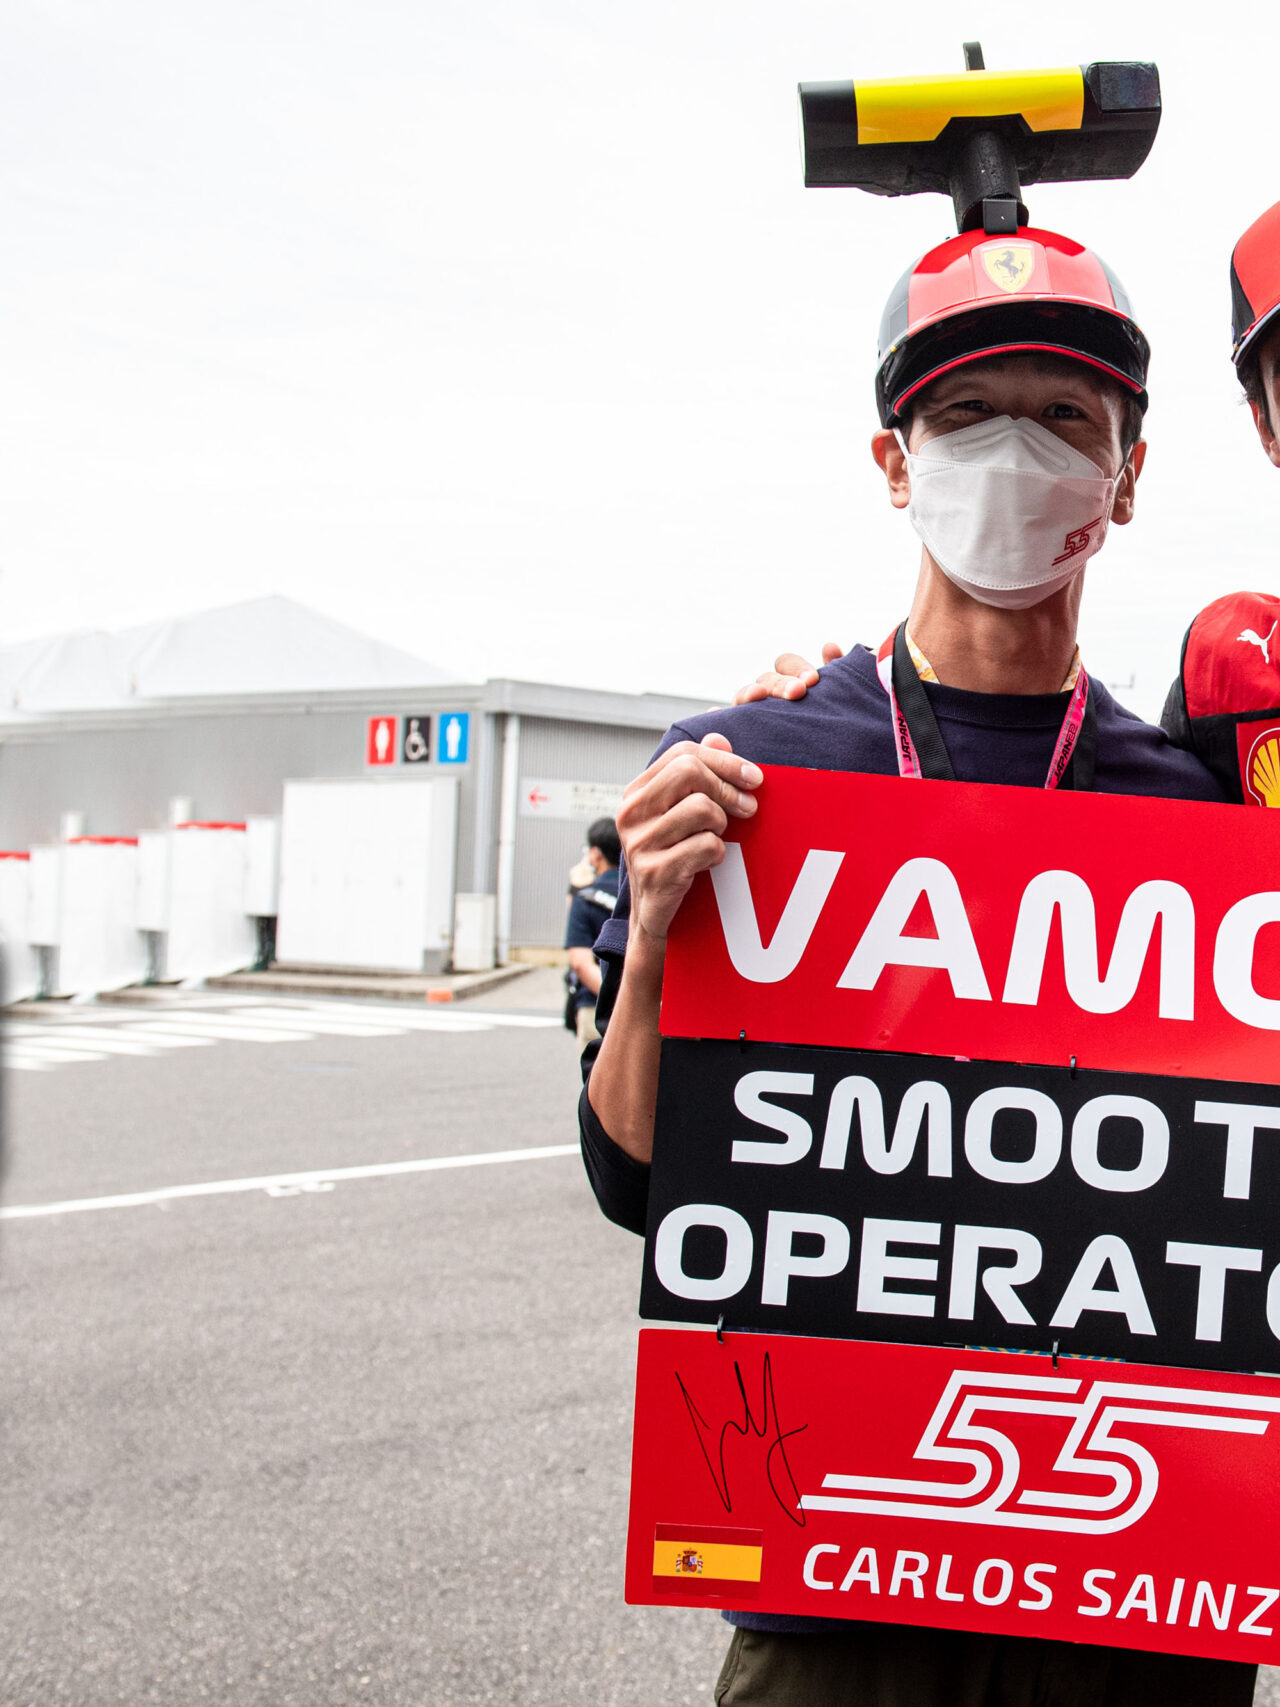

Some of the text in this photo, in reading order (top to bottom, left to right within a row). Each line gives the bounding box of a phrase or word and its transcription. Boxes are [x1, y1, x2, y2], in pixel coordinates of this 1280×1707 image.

[1051, 516, 1102, 566] 55
[897, 712, 912, 762] JAPAN
[802, 1542, 1280, 1637] CARLOS SAINZ
